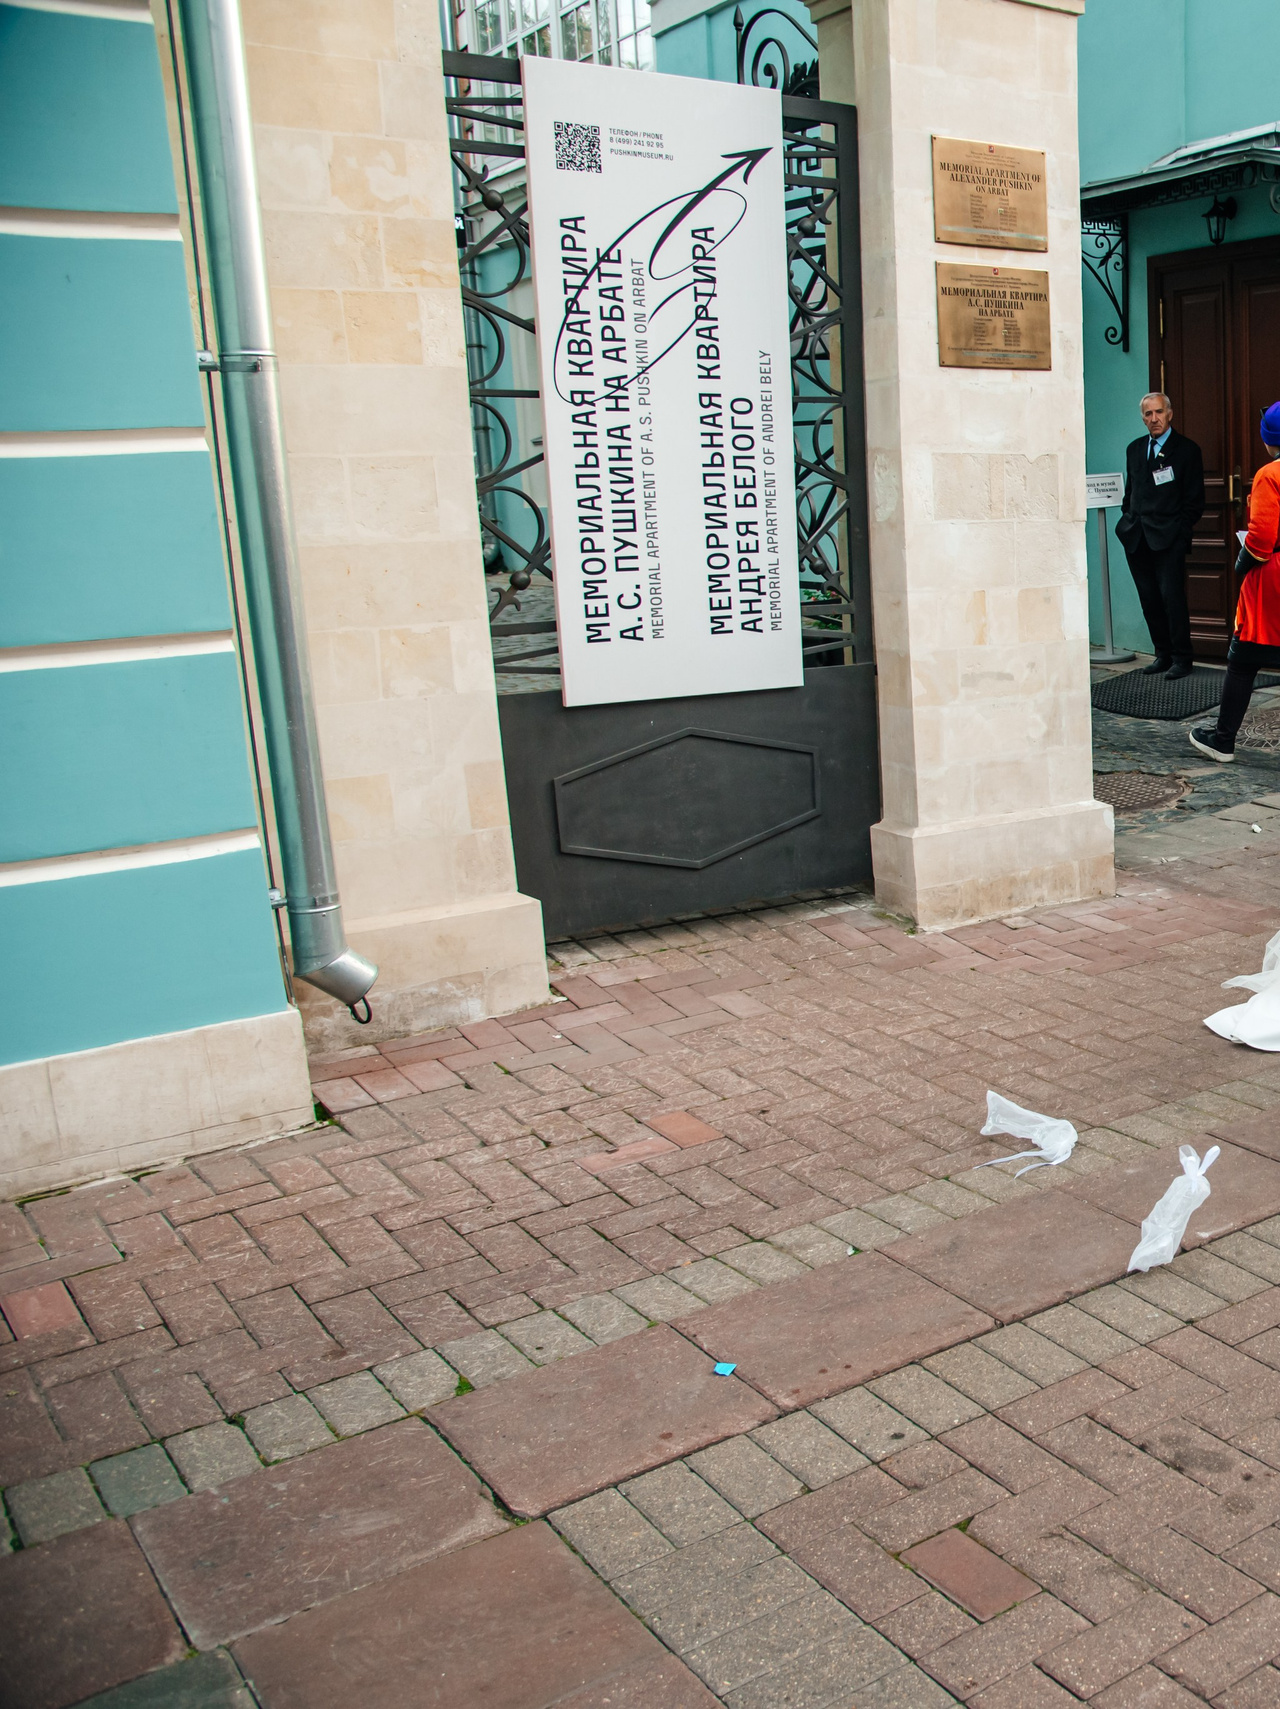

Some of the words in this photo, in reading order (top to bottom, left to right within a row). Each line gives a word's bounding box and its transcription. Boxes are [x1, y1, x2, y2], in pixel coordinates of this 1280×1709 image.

[609, 128, 639, 138] ТЕЛЕФОН
[643, 132, 663, 140] PHONE
[610, 148, 674, 161] PUSHKINMUSEUM.RU
[615, 137, 632, 145] (499)
[940, 162, 984, 176] MEMORIAL
[985, 168, 1031, 182] APARTMENT
[1032, 174, 1041, 183] OF
[950, 173, 997, 187] ALEXANDER
[999, 179, 1033, 191] PUSHKIN
[976, 186, 986, 194] ON
[987, 187, 1009, 196] ARBAT
[560, 216, 594, 376] КВАРТИРА
[597, 248, 627, 363] АРБАТЕ
[631, 258, 645, 307] ARBAT
[691, 227, 721, 379] КВАРТИРА
[941, 286, 1007, 300] МЕМОРИАЛЬНАЯ
[1010, 291, 1048, 302] КВАРТИРА
[984, 299, 1024, 310] ПУШКИНА
[634, 313, 647, 333] ON
[979, 308, 989, 317] НА
[990, 309, 1014, 318] АРБАТЕ
[635, 339, 651, 405] PUSHKIN
[759, 351, 772, 384] BELY
[603, 374, 630, 412] НА
[761, 390, 774, 442] ANDREI
[641, 447, 654, 465] OF
[730, 398, 758, 508] БЕЛОГО
[763, 448, 775, 465] OF
[570, 390, 611, 643] МЕМОРИАЛЬНАЯ
[607, 425, 639, 572] ПУШКИНА
[643, 471, 660, 558] APARTMENT
[699, 393, 733, 634] МЕМОРИАЛЬНАЯ
[764, 470, 779, 553] APARTMENT
[648, 564, 664, 638] MEMORIAL
[736, 521, 766, 633] АНДРЕЯ
[768, 558, 782, 631] MEMORIAL
